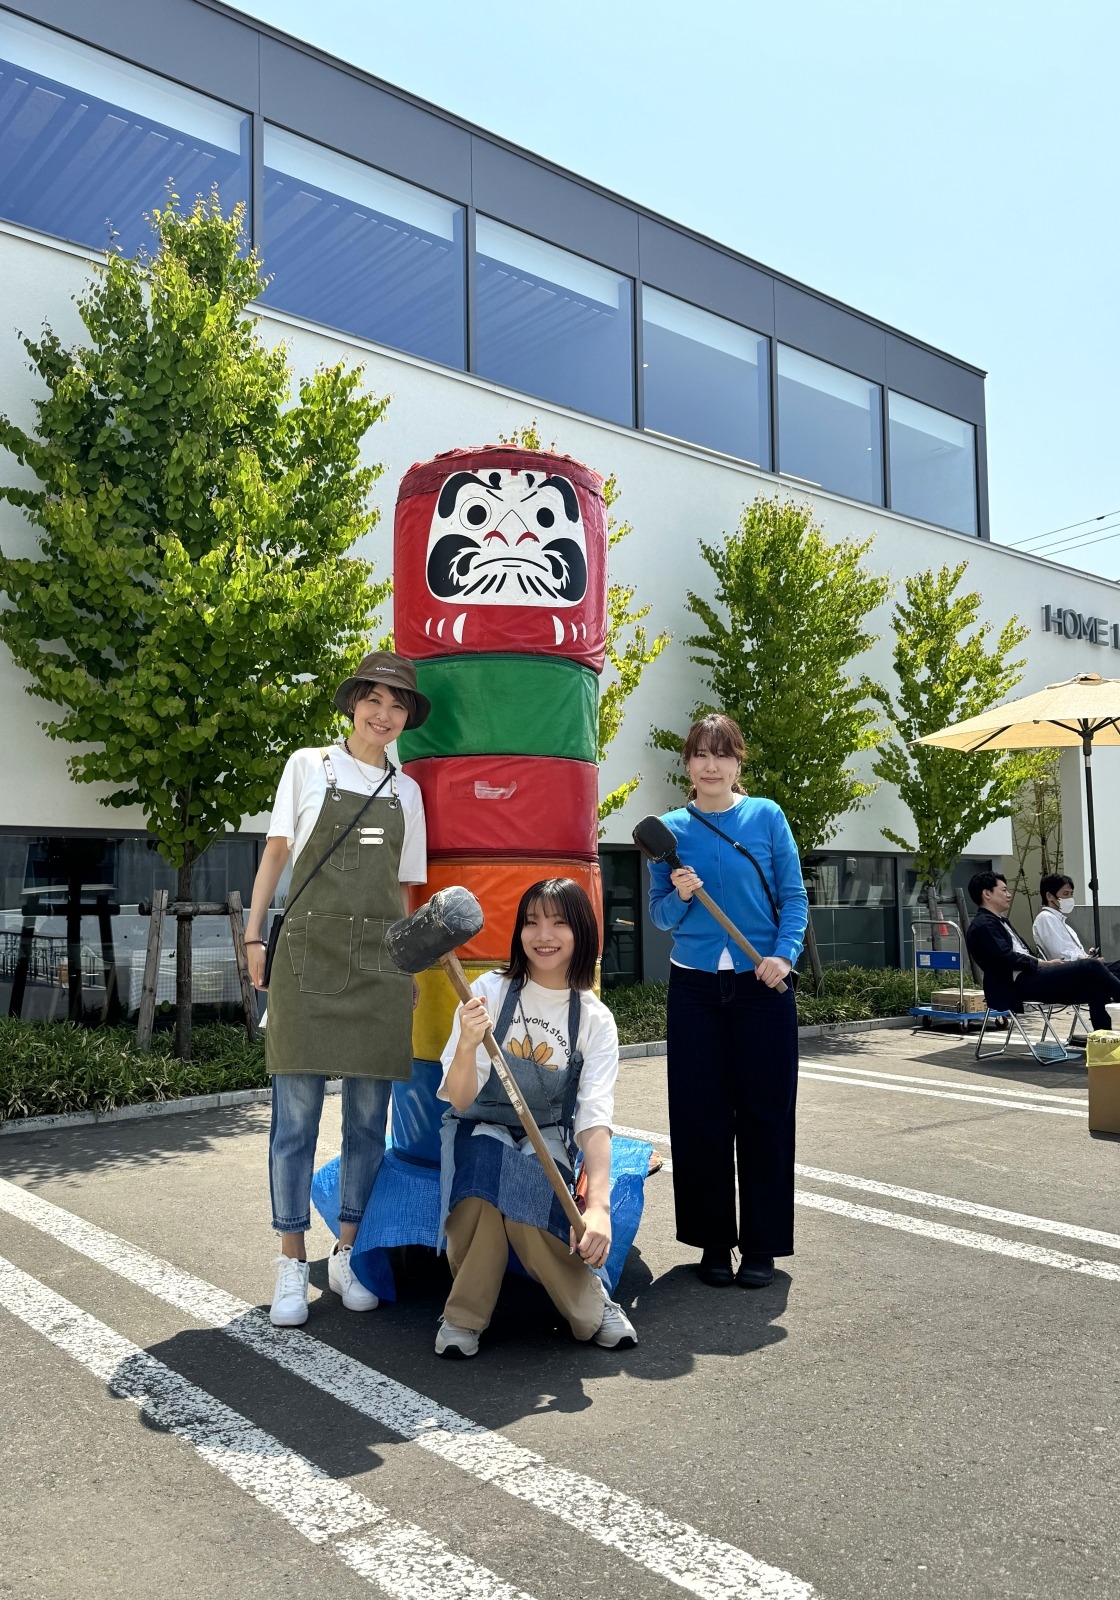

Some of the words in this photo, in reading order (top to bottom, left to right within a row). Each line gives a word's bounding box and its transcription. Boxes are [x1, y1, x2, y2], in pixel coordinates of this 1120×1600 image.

[1044, 604, 1109, 647] HOME
[525, 1017, 550, 1033] world,
[549, 1027, 567, 1047] stop
